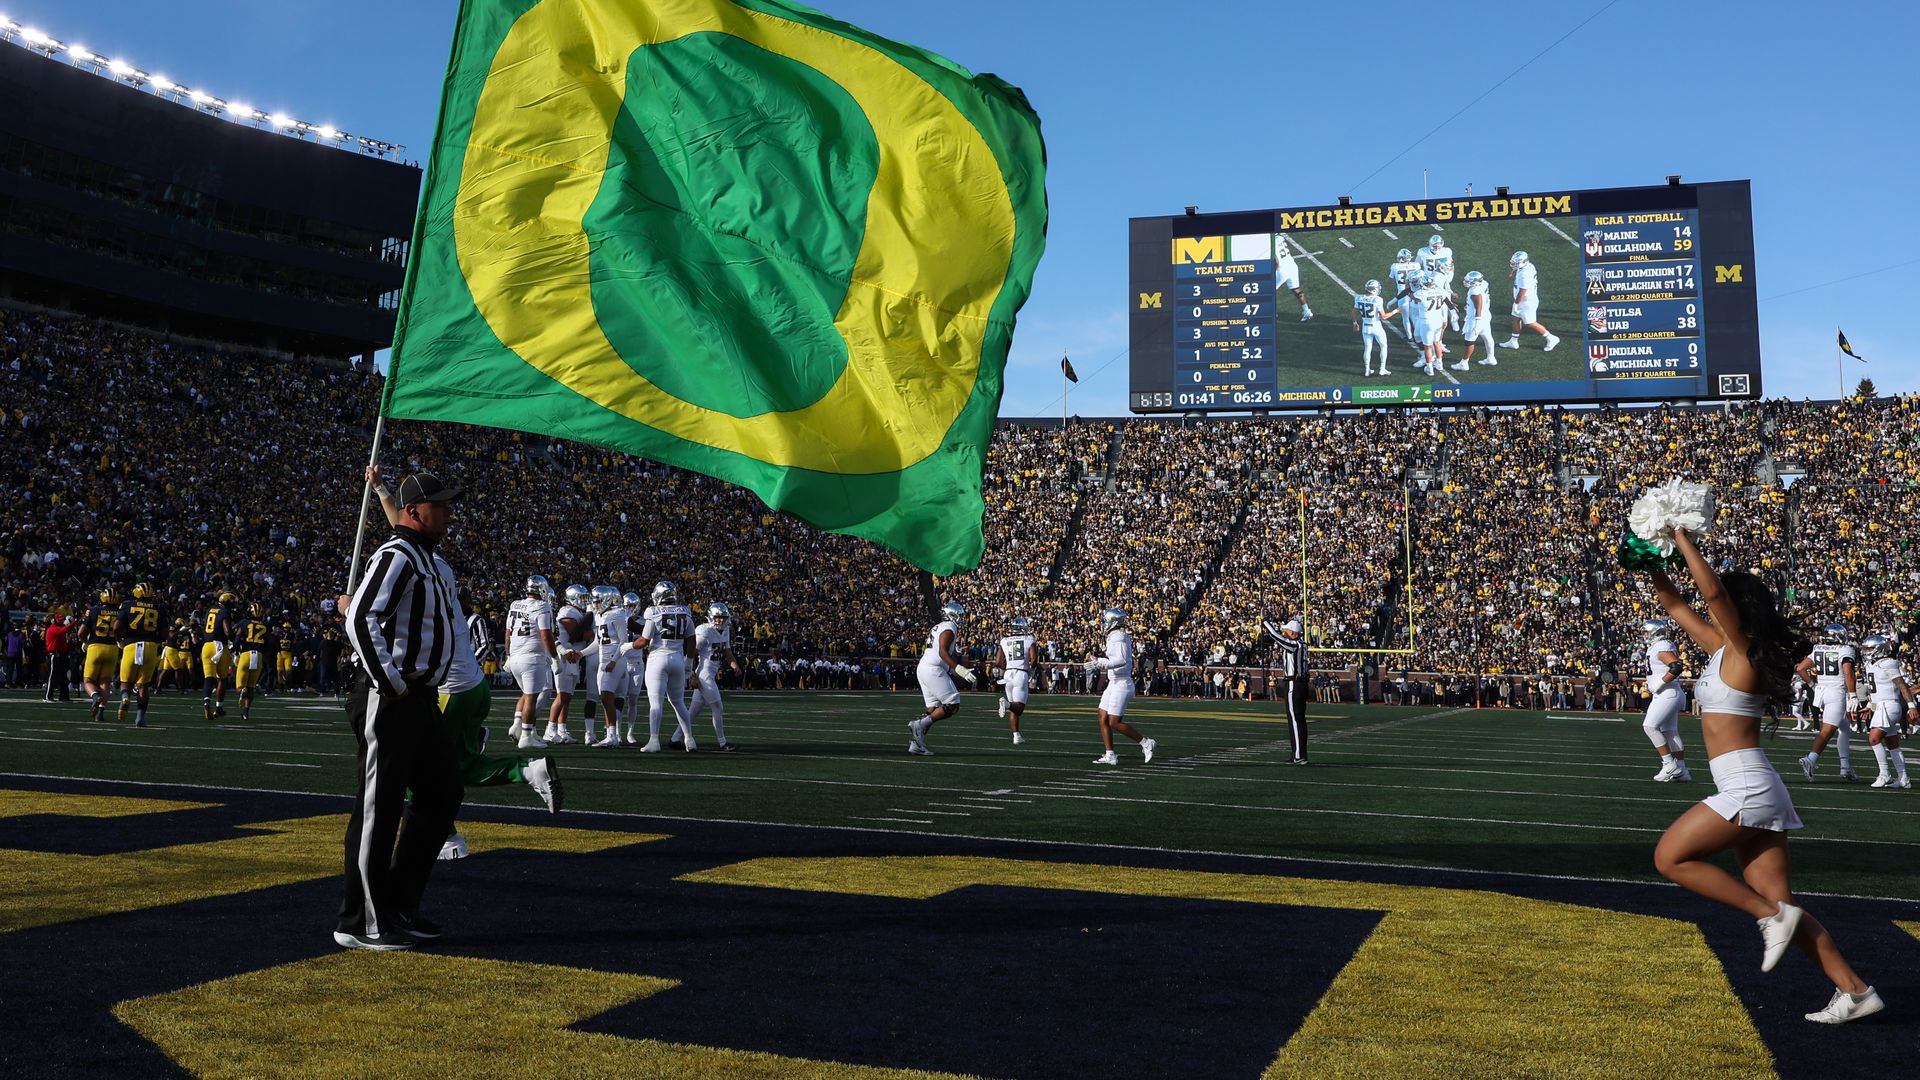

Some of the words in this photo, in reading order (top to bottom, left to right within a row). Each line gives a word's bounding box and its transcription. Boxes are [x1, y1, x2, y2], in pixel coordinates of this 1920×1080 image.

[1280, 204, 1426, 229] MICHIGAN
[1436, 196, 1571, 220] STADIUM
[1595, 216, 1624, 225] NCAA
[1628, 213, 1683, 223] FOOTBALL
[1604, 231, 1638, 240] MAINE
[1674, 226, 1691, 238] 14
[1604, 243, 1662, 253] OKLAHOMA
[1674, 239, 1692, 250] 59
[1195, 266, 1222, 275] TEAM
[1226, 264, 1255, 274] STATS
[1606, 270, 1623, 278] OLD
[1627, 268, 1674, 278] DOMINION
[1676, 265, 1693, 276] 17
[1715, 265, 1742, 282] M
[1193, 286, 1201, 296] 3
[1243, 283, 1259, 294] 63
[1606, 282, 1662, 292] APPALACHIAN
[1665, 281, 1675, 289] ST
[1676, 278, 1694, 289] 14
[1140, 292, 1162, 308] M
[1193, 307, 1201, 318] 0
[1243, 304, 1260, 315] 47
[1607, 308, 1642, 317] TULSA
[1686, 304, 1695, 315] 0
[1608, 321, 1629, 330] UAB
[1678, 317, 1696, 328] 38
[1193, 328, 1201, 339] 3
[1244, 326, 1260, 337] 16
[1194, 350, 1200, 360] 1
[1242, 348, 1262, 359] 5.2
[1609, 346, 1653, 356] INDIANA
[1688, 343, 1697, 354] 0
[1610, 360, 1661, 369] MICHIGAN
[1665, 358, 1679, 367] ST
[1689, 356, 1698, 367] 3
[1193, 372, 1202, 382] 0
[1248, 370, 1256, 380] 0
[1722, 377, 1746, 392] 25
[1180, 393, 1215, 404] 01:41
[1234, 392, 1271, 403] 06:26
[1280, 392, 1326, 401] MICHIGAN
[1333, 389, 1342, 400] 0
[1360, 390, 1398, 398] OREGON
[1411, 388, 1420, 398] 7
[1455, 389, 1460, 397] 1
[130, 606, 158, 632] 78
[205, 613, 216, 634] 8
[246, 623, 267, 644] 12
